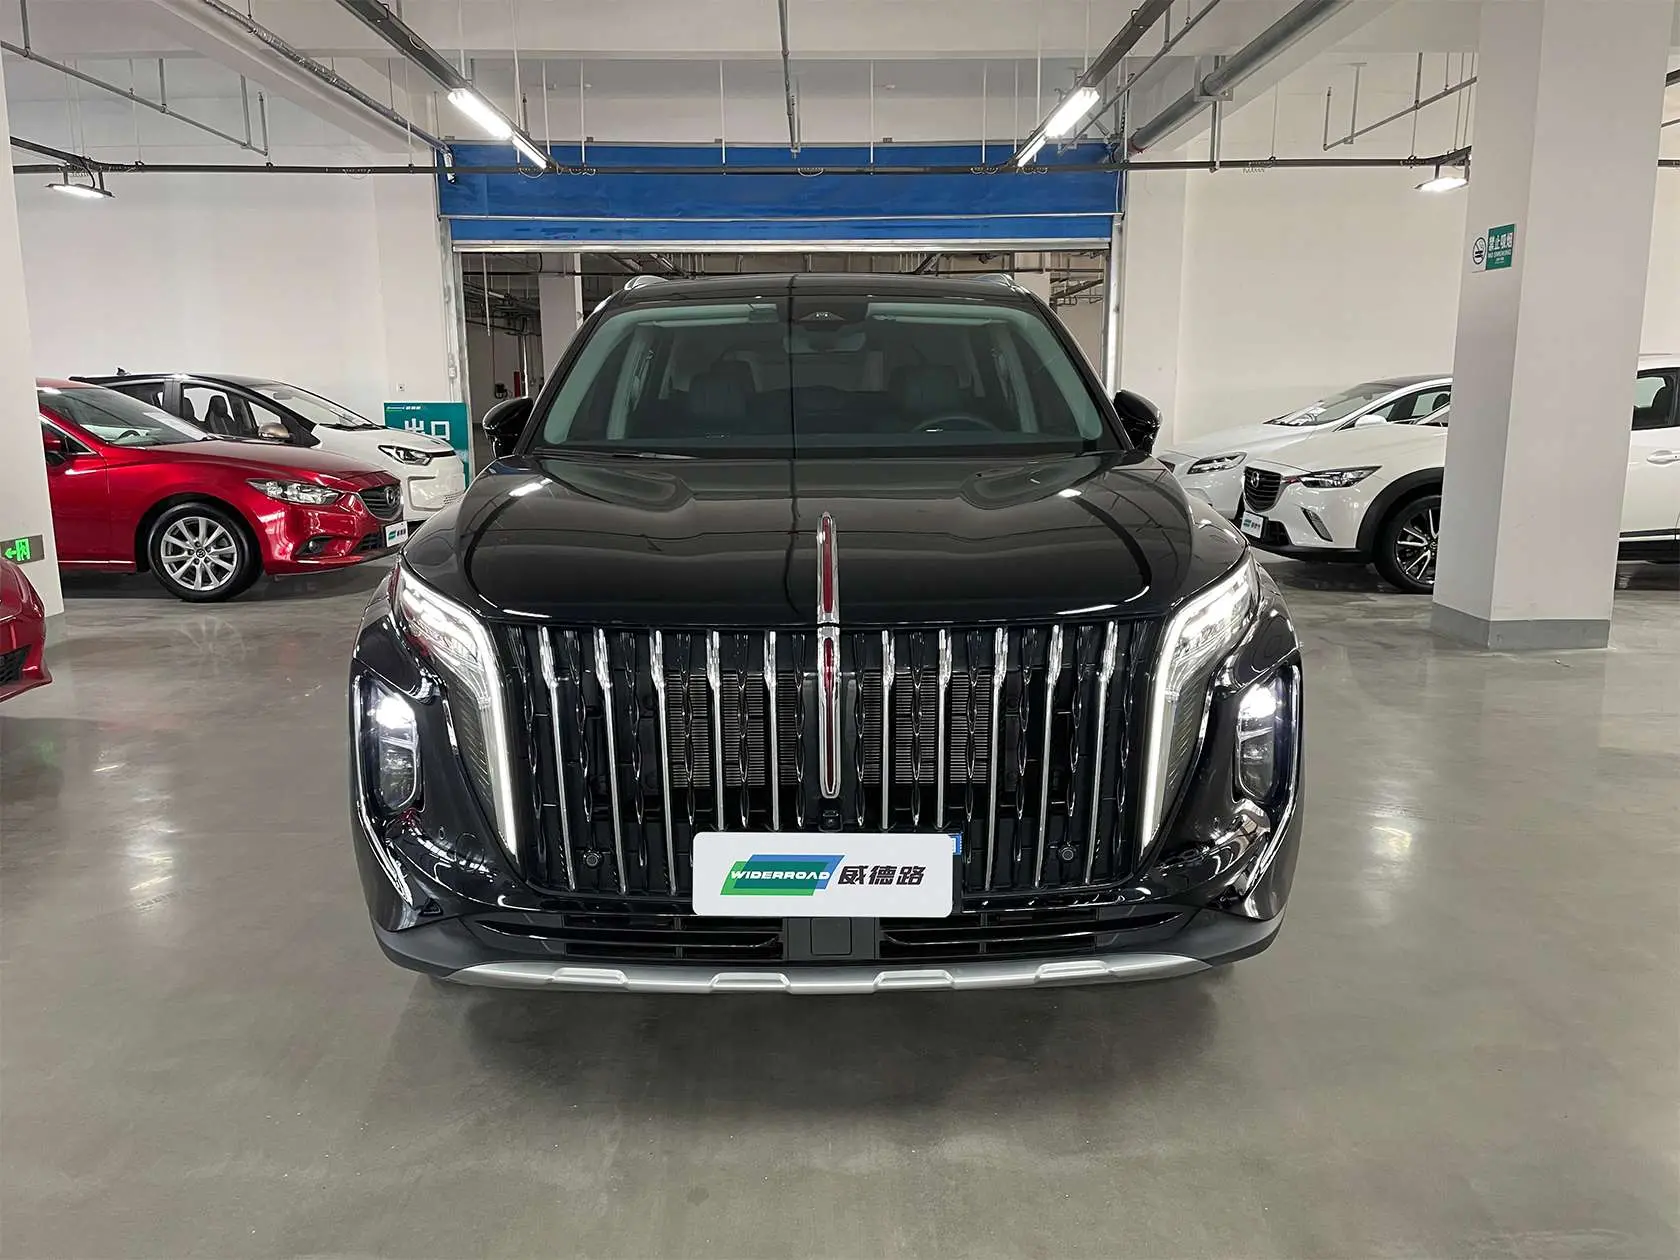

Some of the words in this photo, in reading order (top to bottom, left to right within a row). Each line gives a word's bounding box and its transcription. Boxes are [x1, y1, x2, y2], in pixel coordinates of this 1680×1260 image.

[731, 870, 831, 880] WIDERROAD
[838, 865, 926, 886] 威德路
